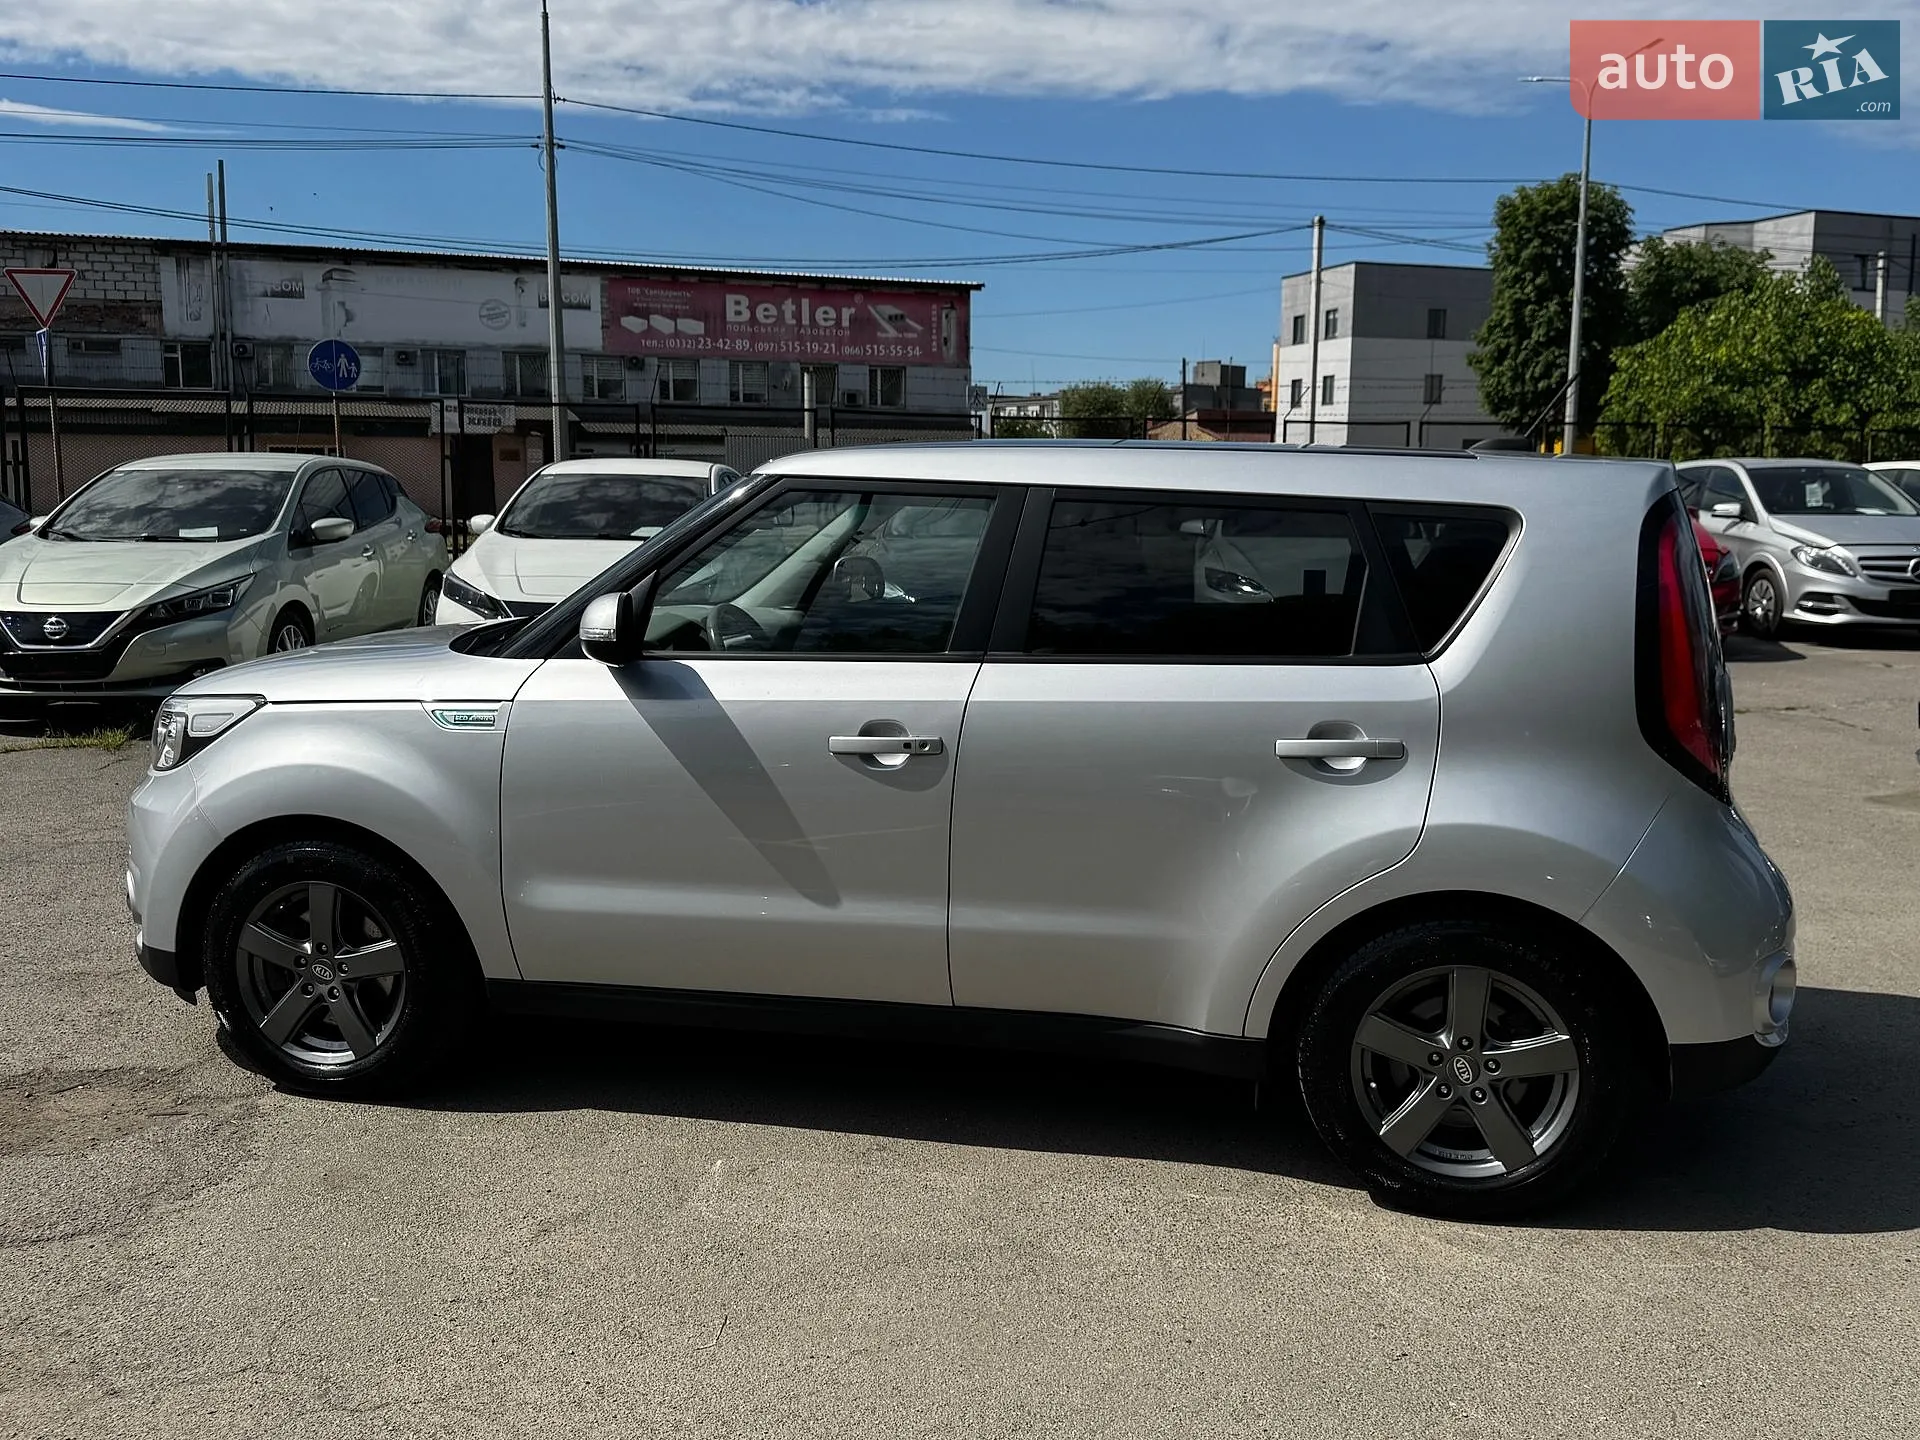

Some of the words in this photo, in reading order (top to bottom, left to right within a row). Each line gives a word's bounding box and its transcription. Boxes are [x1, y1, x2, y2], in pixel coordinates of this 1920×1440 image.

[725, 293, 856, 328] Betler
[754, 342, 778, 353] (097)
[314, 965, 331, 979] KIA
[1456, 1060, 1470, 1080] KIA
